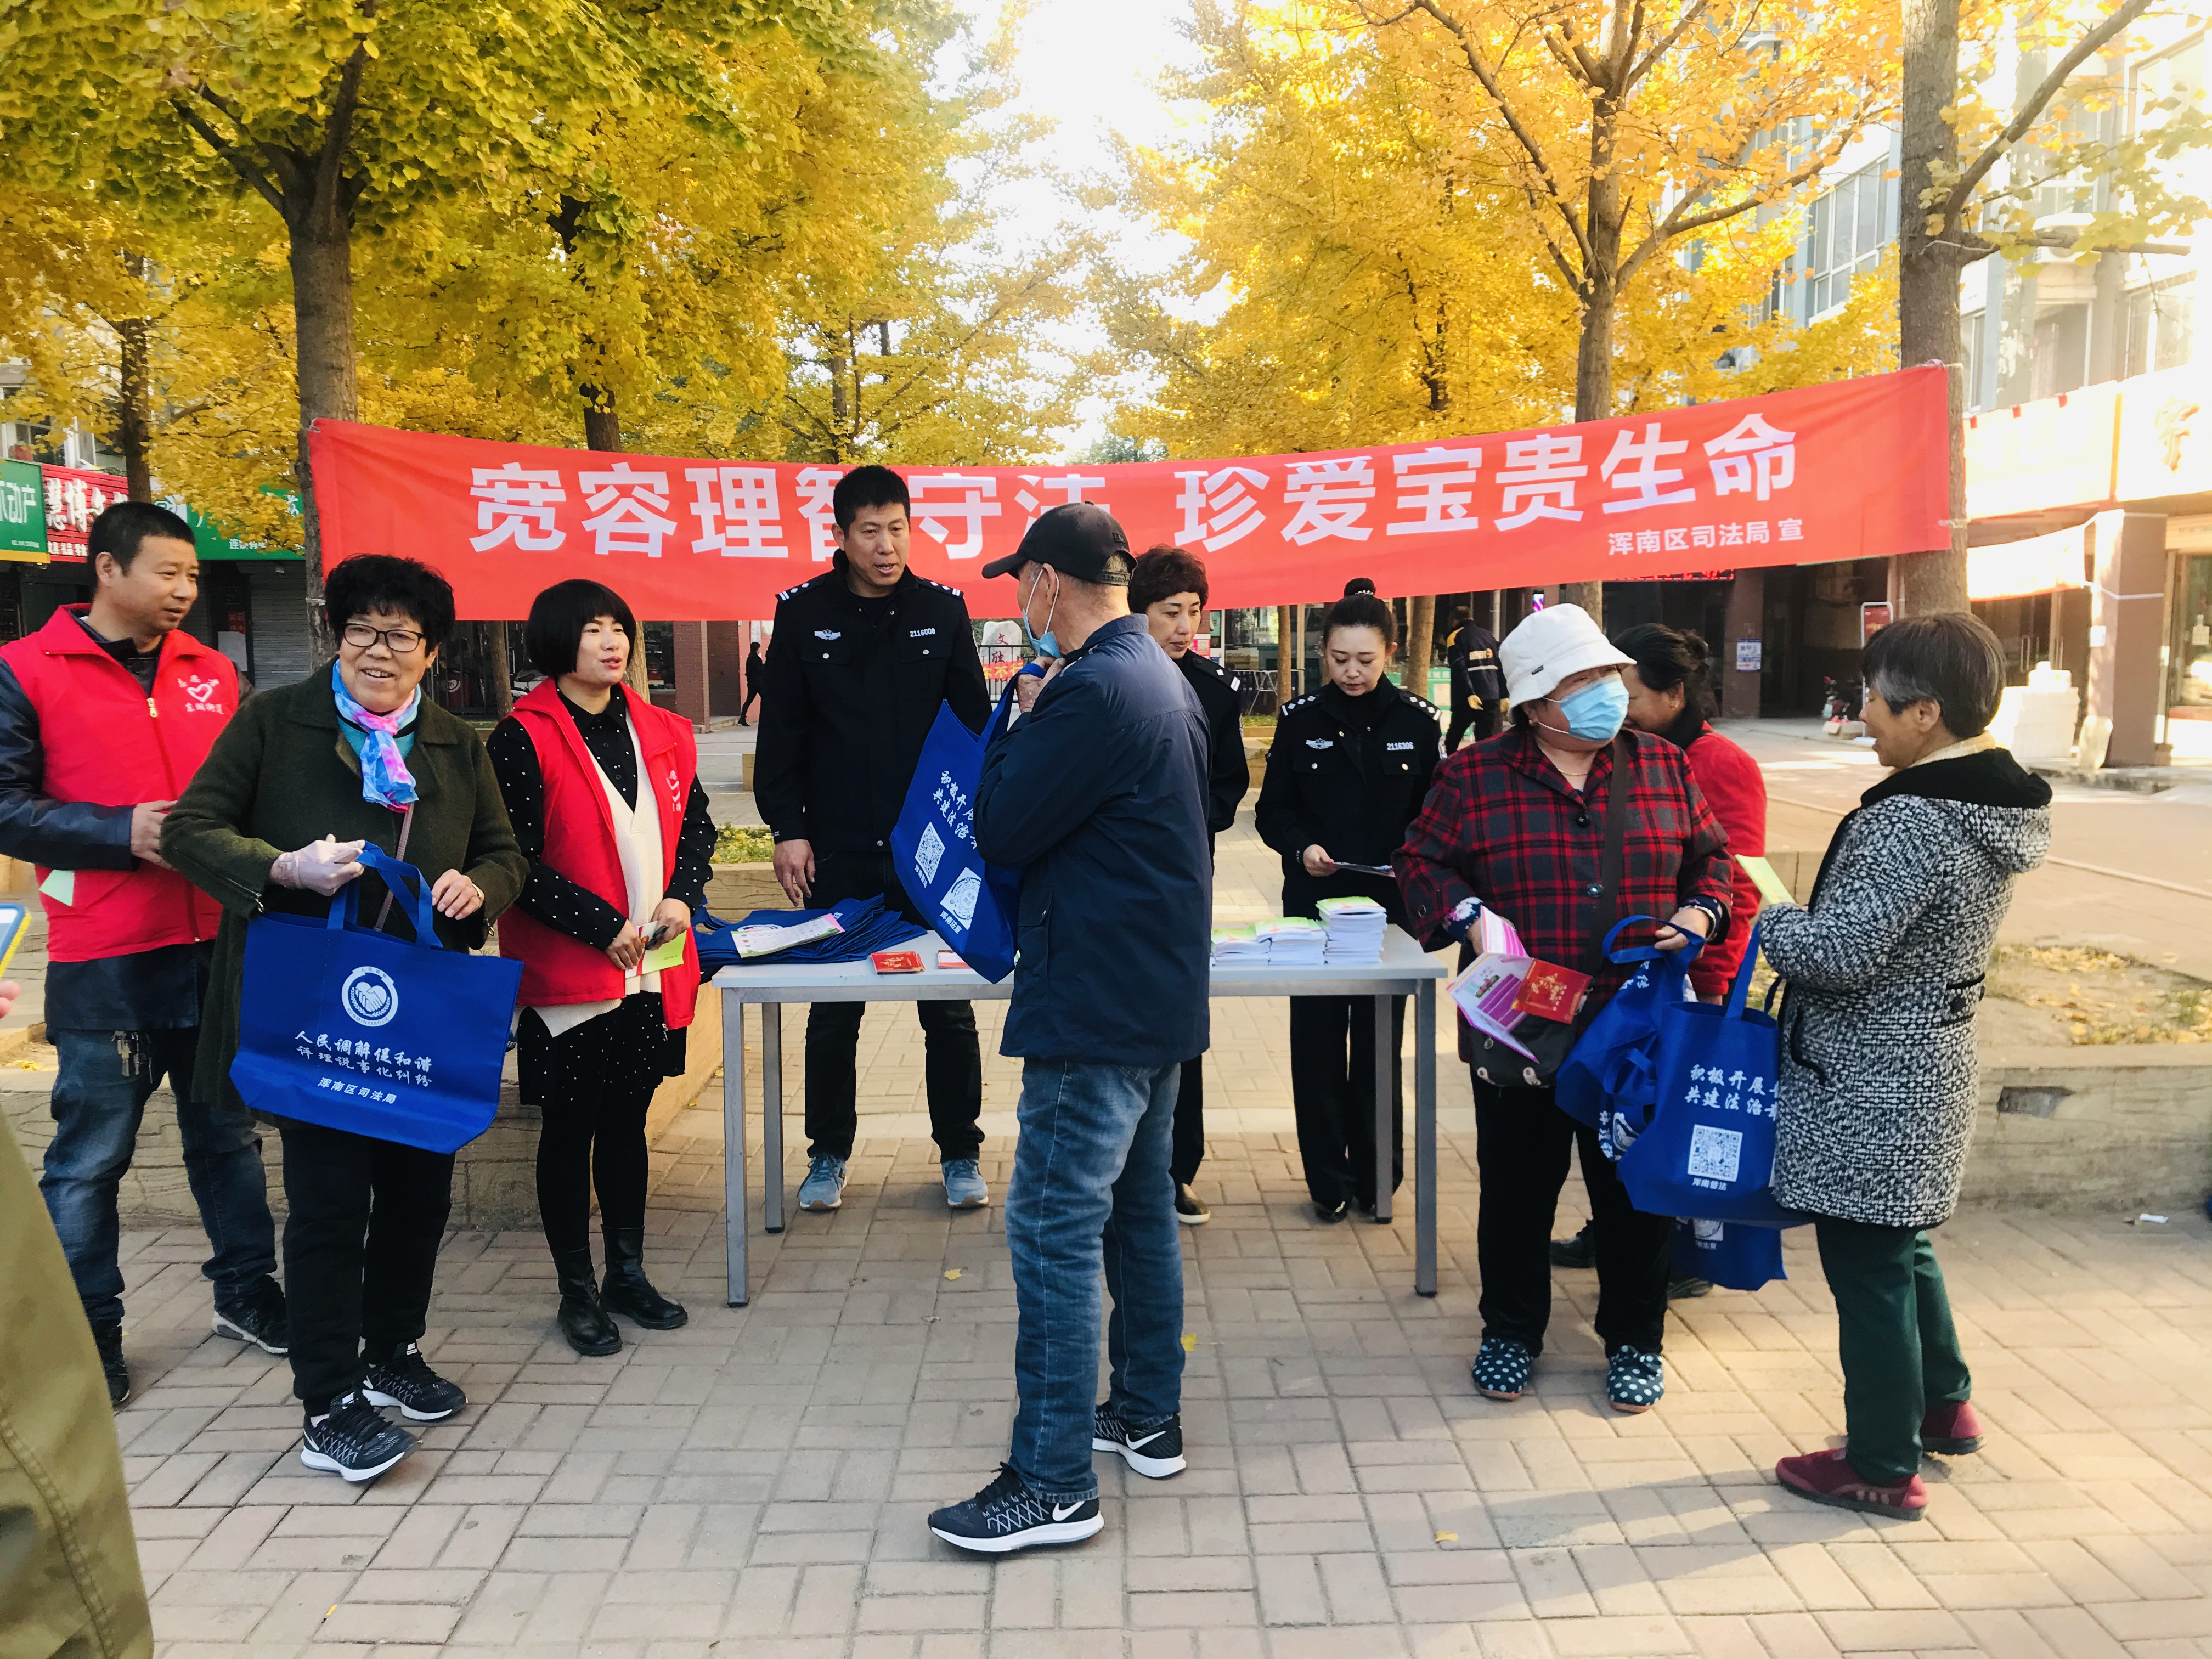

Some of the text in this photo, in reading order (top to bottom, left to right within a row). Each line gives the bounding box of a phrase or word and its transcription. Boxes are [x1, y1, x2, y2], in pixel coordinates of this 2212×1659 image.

[1174, 413, 1796, 553] 珍爱宝贵生命
[1608, 518, 1804, 556] 浑南区司法局 宣
[295, 1030, 432, 1073] 人民调解促和谐
[296, 1045, 432, 1087] 评理说事化纠纷
[317, 1076, 398, 1105] 浑南区司法局
